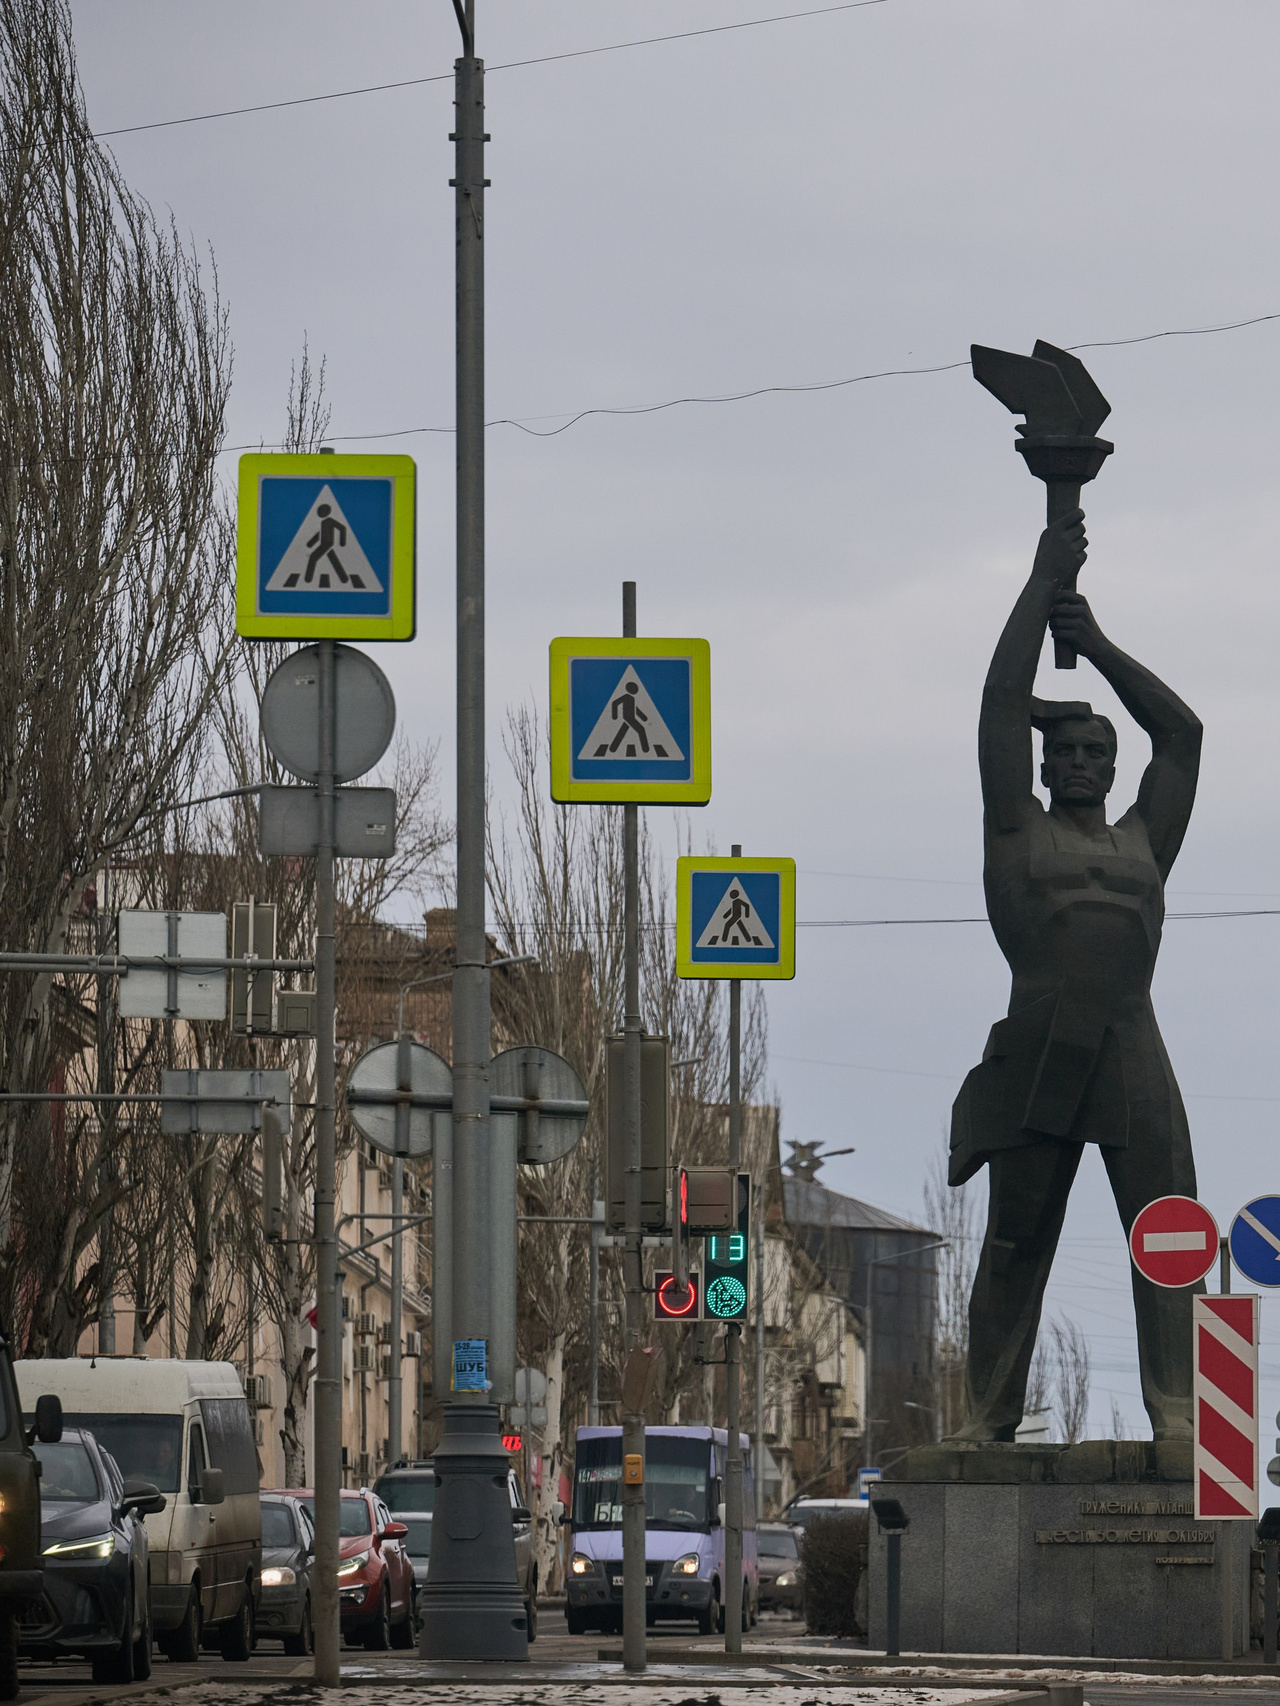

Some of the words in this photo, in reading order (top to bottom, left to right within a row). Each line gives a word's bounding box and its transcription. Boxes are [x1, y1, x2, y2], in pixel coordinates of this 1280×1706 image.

[711, 1235, 744, 1261] 13
[456, 1362, 484, 1372] ШУБ
[1166, 1530, 1215, 1543] ОКТЯБРЯ
